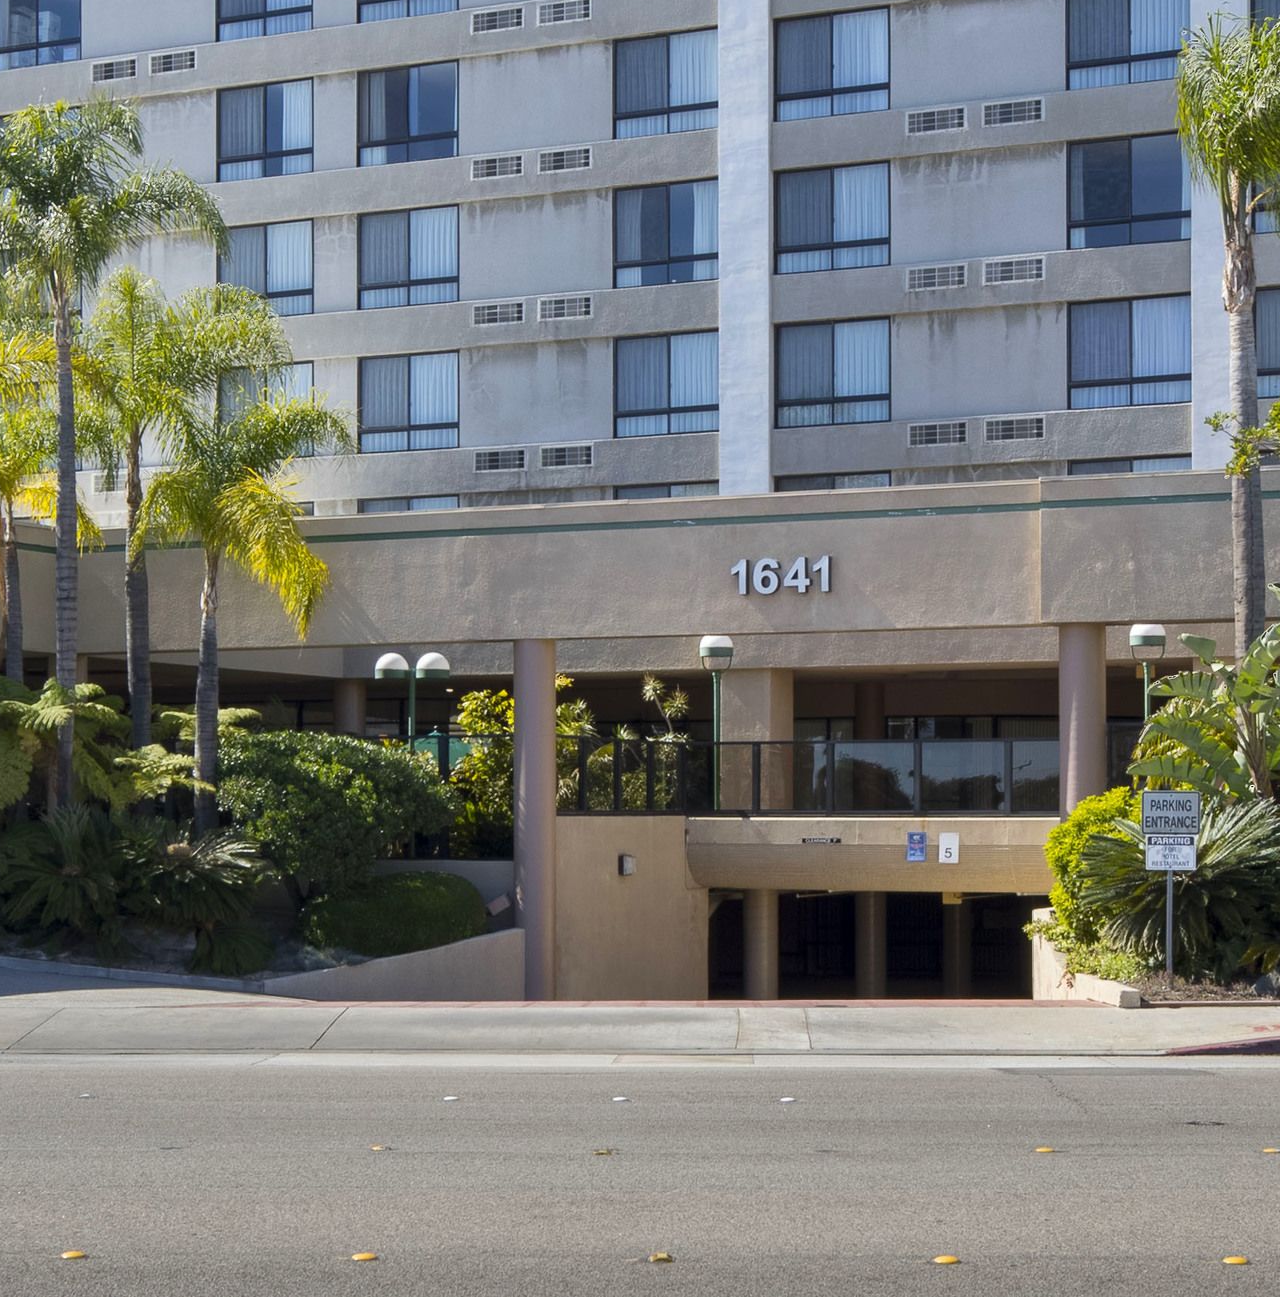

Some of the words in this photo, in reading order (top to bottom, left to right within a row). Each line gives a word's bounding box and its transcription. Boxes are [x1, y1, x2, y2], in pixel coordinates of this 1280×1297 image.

[730, 555, 830, 595] 1641
[1150, 799, 1192, 812] PARKING
[1145, 815, 1197, 828] ENTRANCE
[1151, 837, 1191, 845] PARKING
[944, 847, 953, 859] 5
